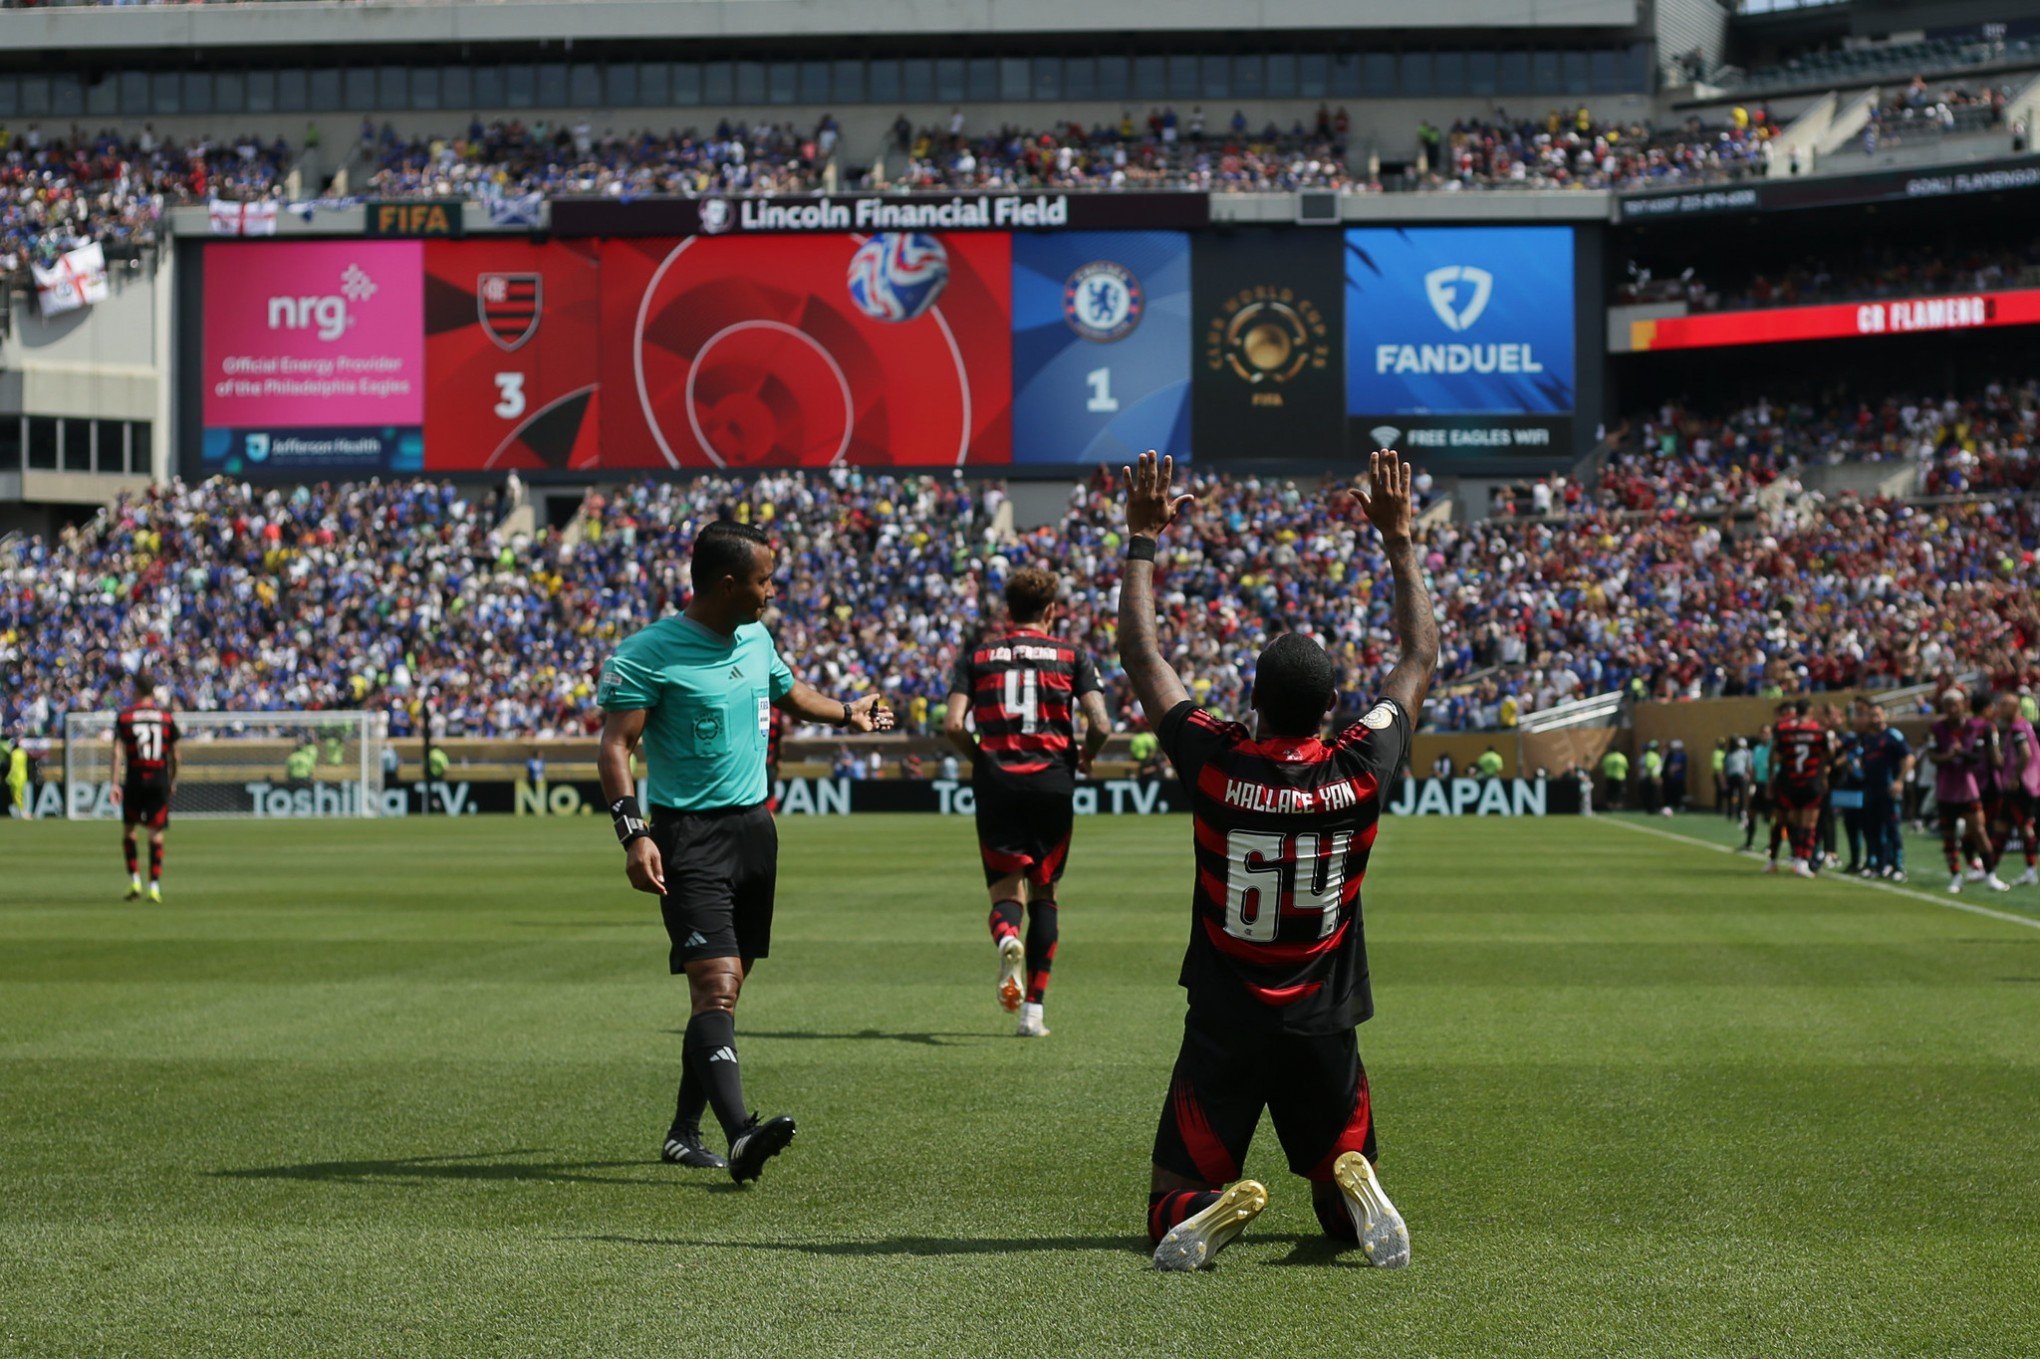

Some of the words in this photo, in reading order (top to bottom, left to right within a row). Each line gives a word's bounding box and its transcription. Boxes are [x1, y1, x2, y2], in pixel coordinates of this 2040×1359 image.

[379, 205, 448, 233] FIFA
[741, 198, 849, 229] Lincoln
[855, 195, 990, 228] Financial
[994, 195, 1067, 226] Field
[223, 356, 275, 374] Official
[280, 356, 333, 375] Energy
[337, 356, 401, 374] Provider
[1376, 344, 1543, 374] FANDUEL
[215, 381, 232, 396] of
[235, 379, 261, 394] the
[265, 379, 355, 396] Philadelphia
[359, 379, 410, 396] Eagles
[494, 372, 525, 418] 3
[1087, 367, 1118, 412] 1
[1407, 429, 1447, 446] FREE
[1451, 429, 1511, 445] EAGLES
[1004, 669, 1038, 735] 4
[132, 723, 162, 761] 21
[8, 780, 123, 820] JAPA
[514, 778, 592, 817] No.
[1105, 780, 1168, 815] TV.
[1225, 779, 1315, 814] WALLACE
[1320, 781, 1356, 812] YAN
[1389, 778, 1546, 816] JAPAN
[1223, 829, 1354, 943] 64
